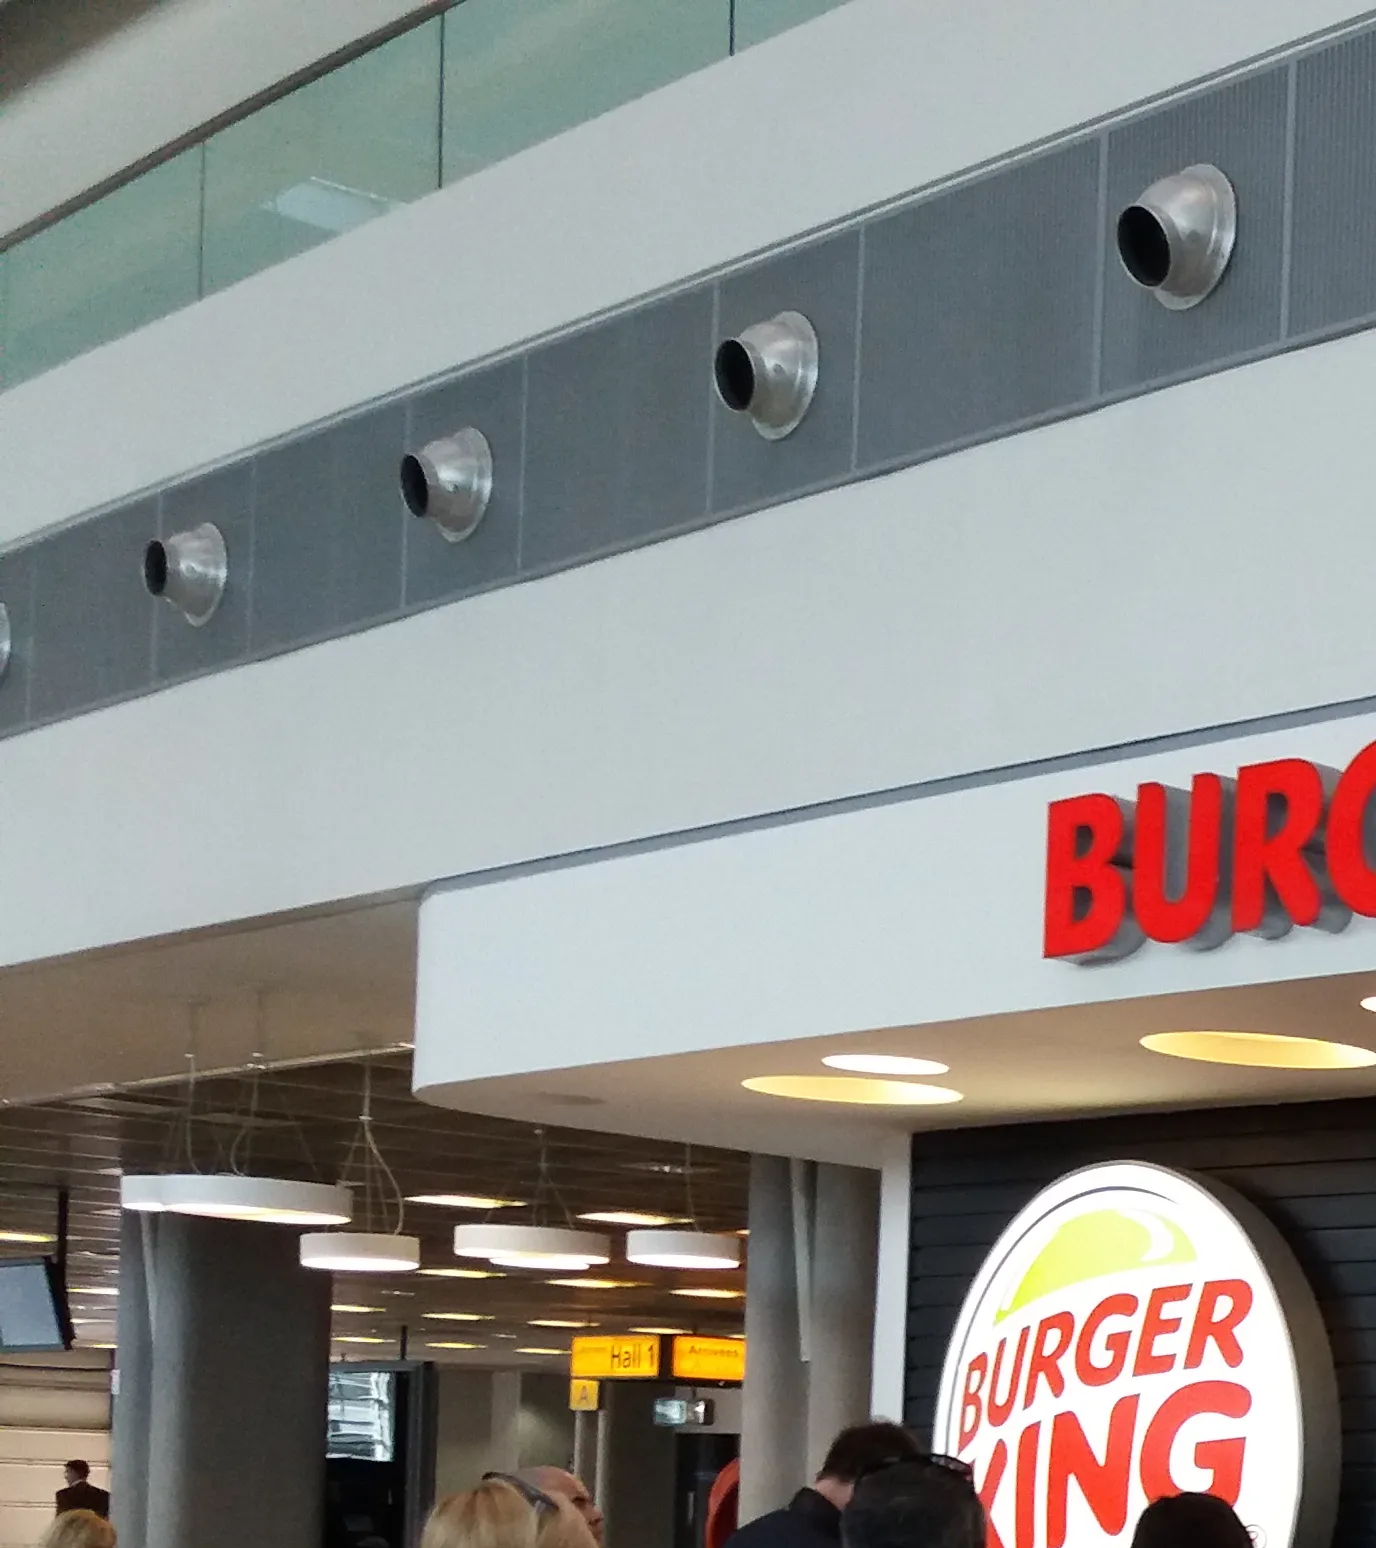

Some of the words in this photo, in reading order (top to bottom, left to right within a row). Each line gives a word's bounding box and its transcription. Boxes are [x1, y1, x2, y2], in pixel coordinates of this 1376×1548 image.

[610, 1344, 642, 1370] Hall
[647, 1344, 656, 1369] 1
[957, 1278, 1254, 1456] BURGER
[579, 1384, 590, 1405] A
